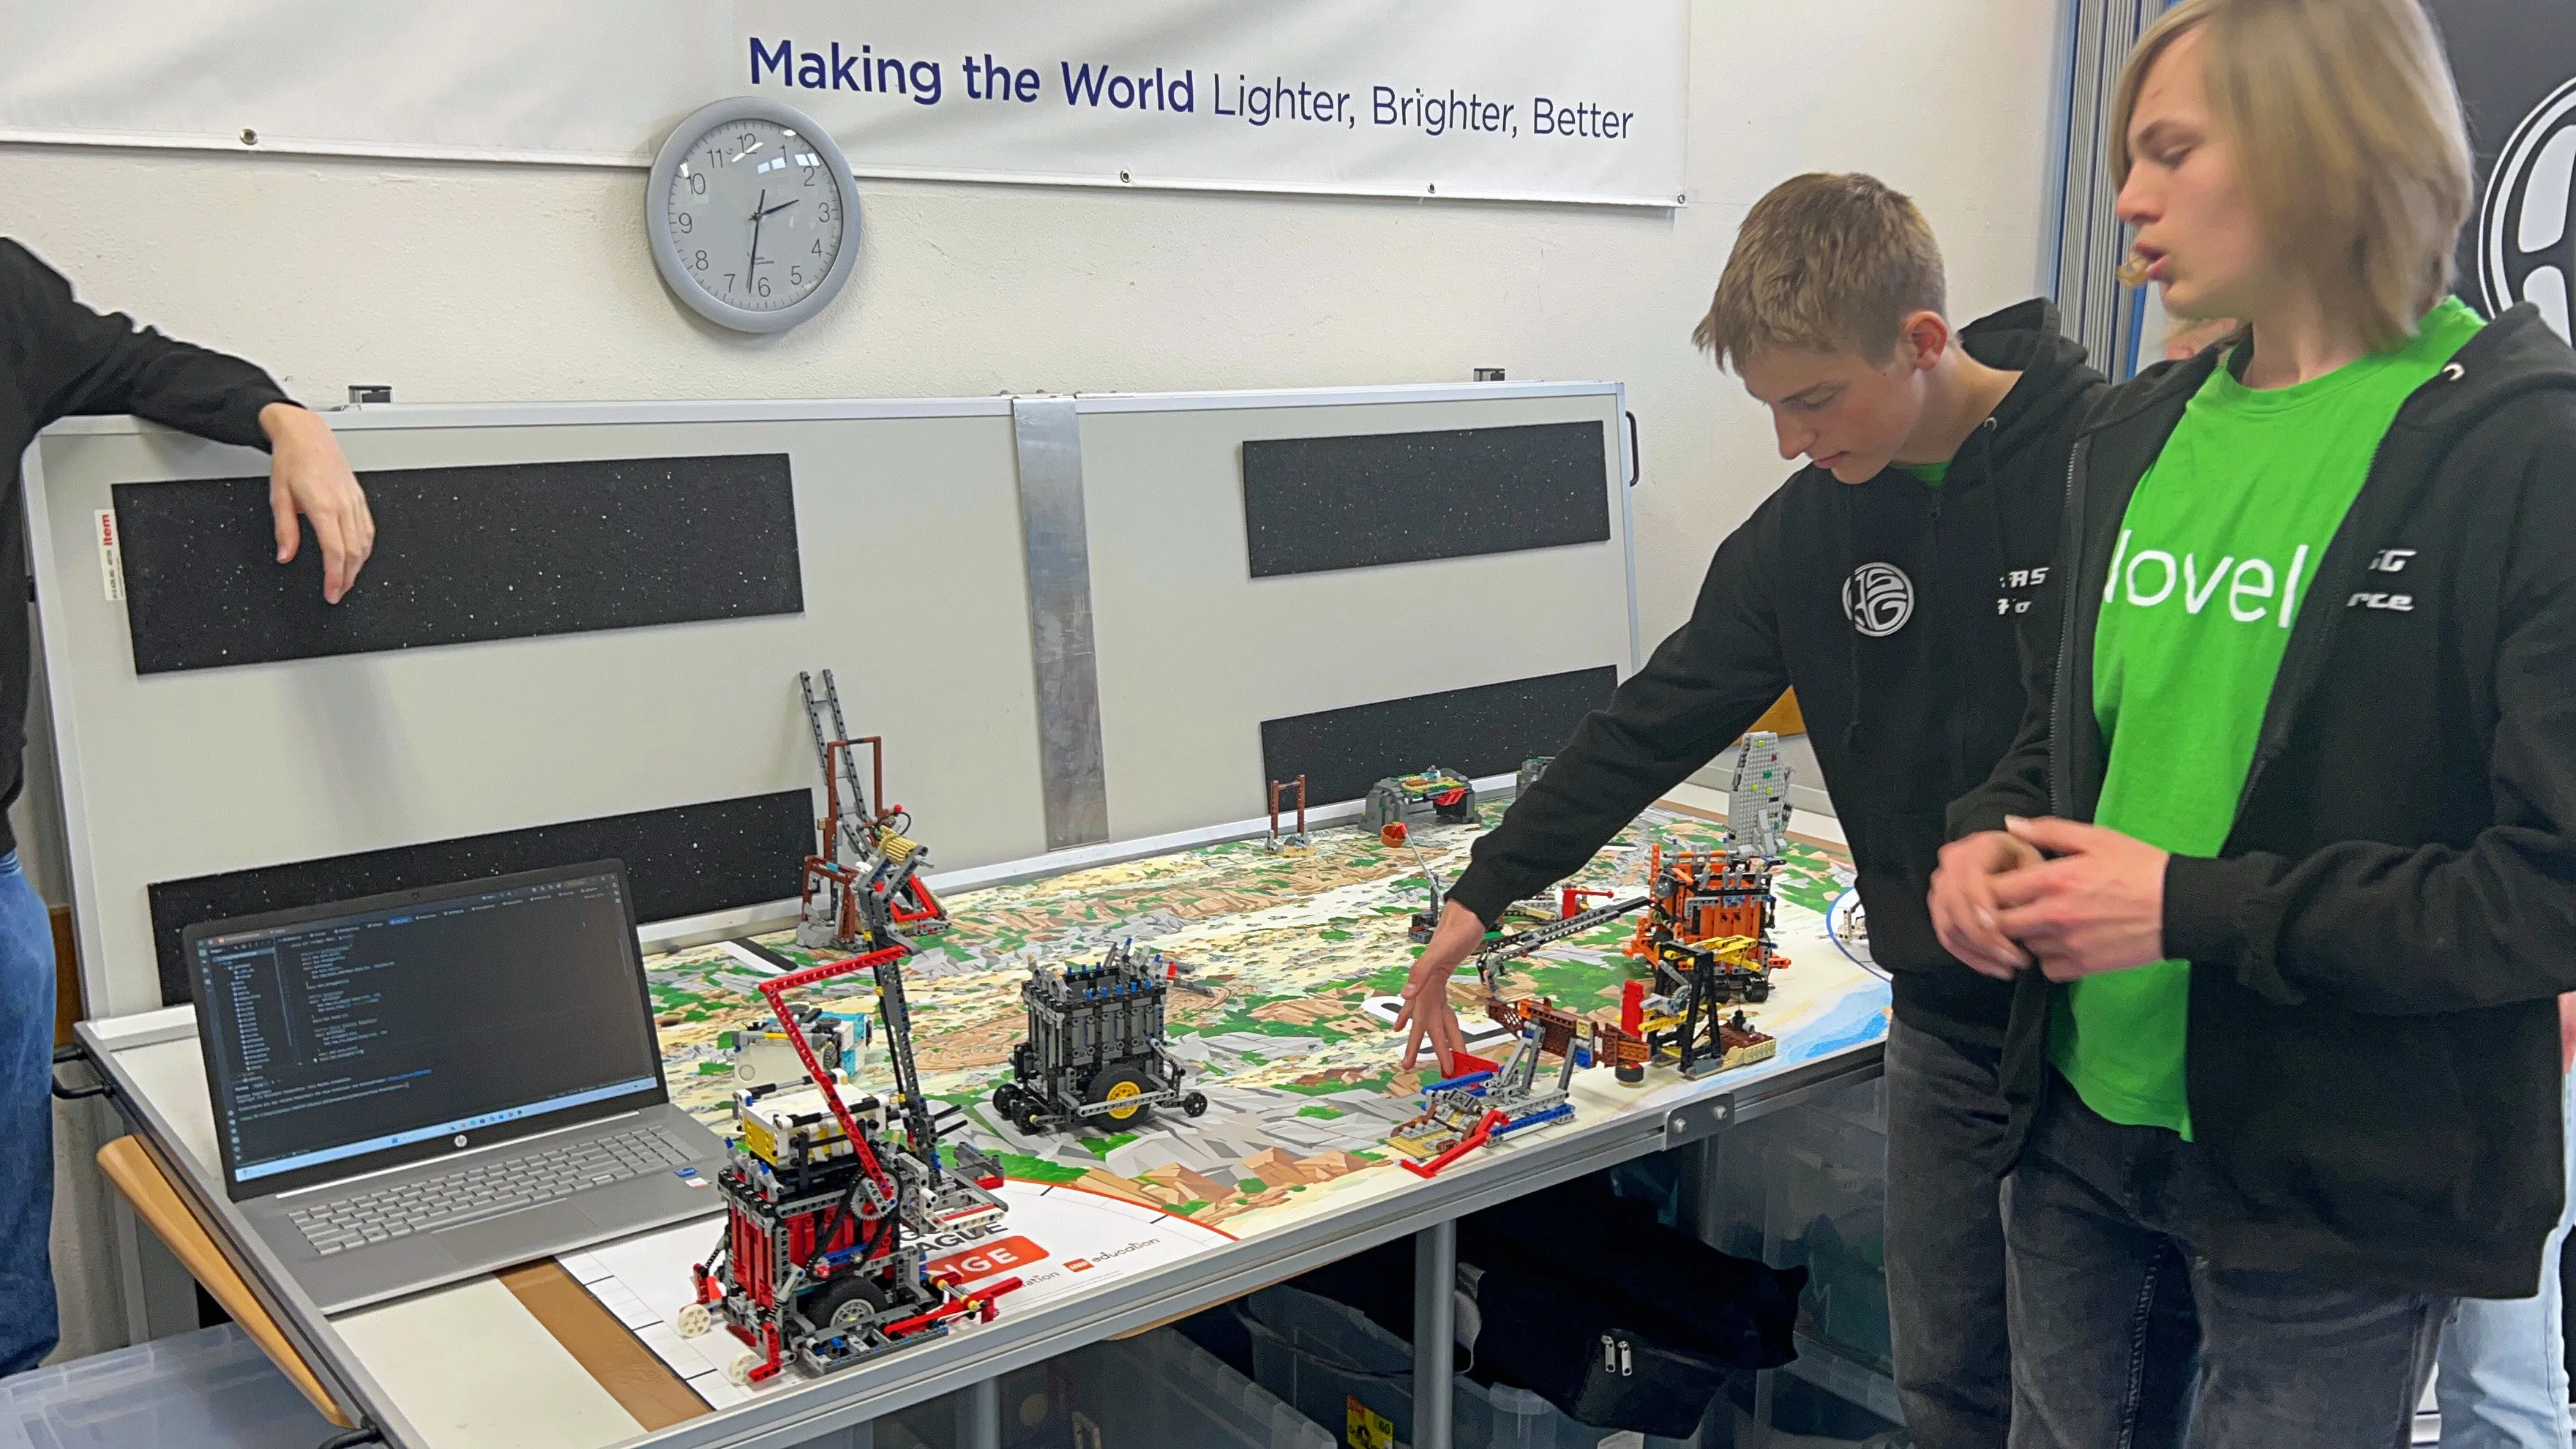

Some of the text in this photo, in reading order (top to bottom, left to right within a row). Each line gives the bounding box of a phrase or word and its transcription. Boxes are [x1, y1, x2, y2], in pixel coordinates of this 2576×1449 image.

[749, 37, 1634, 139] Making the World Lighter, Brighter, Better
[736, 133, 757, 154] 12
[706, 148, 723, 168] 11
[779, 145, 788, 164] 1
[686, 173, 706, 195] 10
[803, 166, 815, 187] 2
[818, 203, 831, 222] 3
[678, 213, 693, 233] 9
[811, 239, 823, 258] 4
[695, 250, 709, 271] 8
[724, 273, 736, 293] 7
[790, 266, 802, 285] 5
[757, 277, 771, 297] 6
[1091, 1238, 1161, 1262] education
[1022, 1271, 1060, 1288] ation
